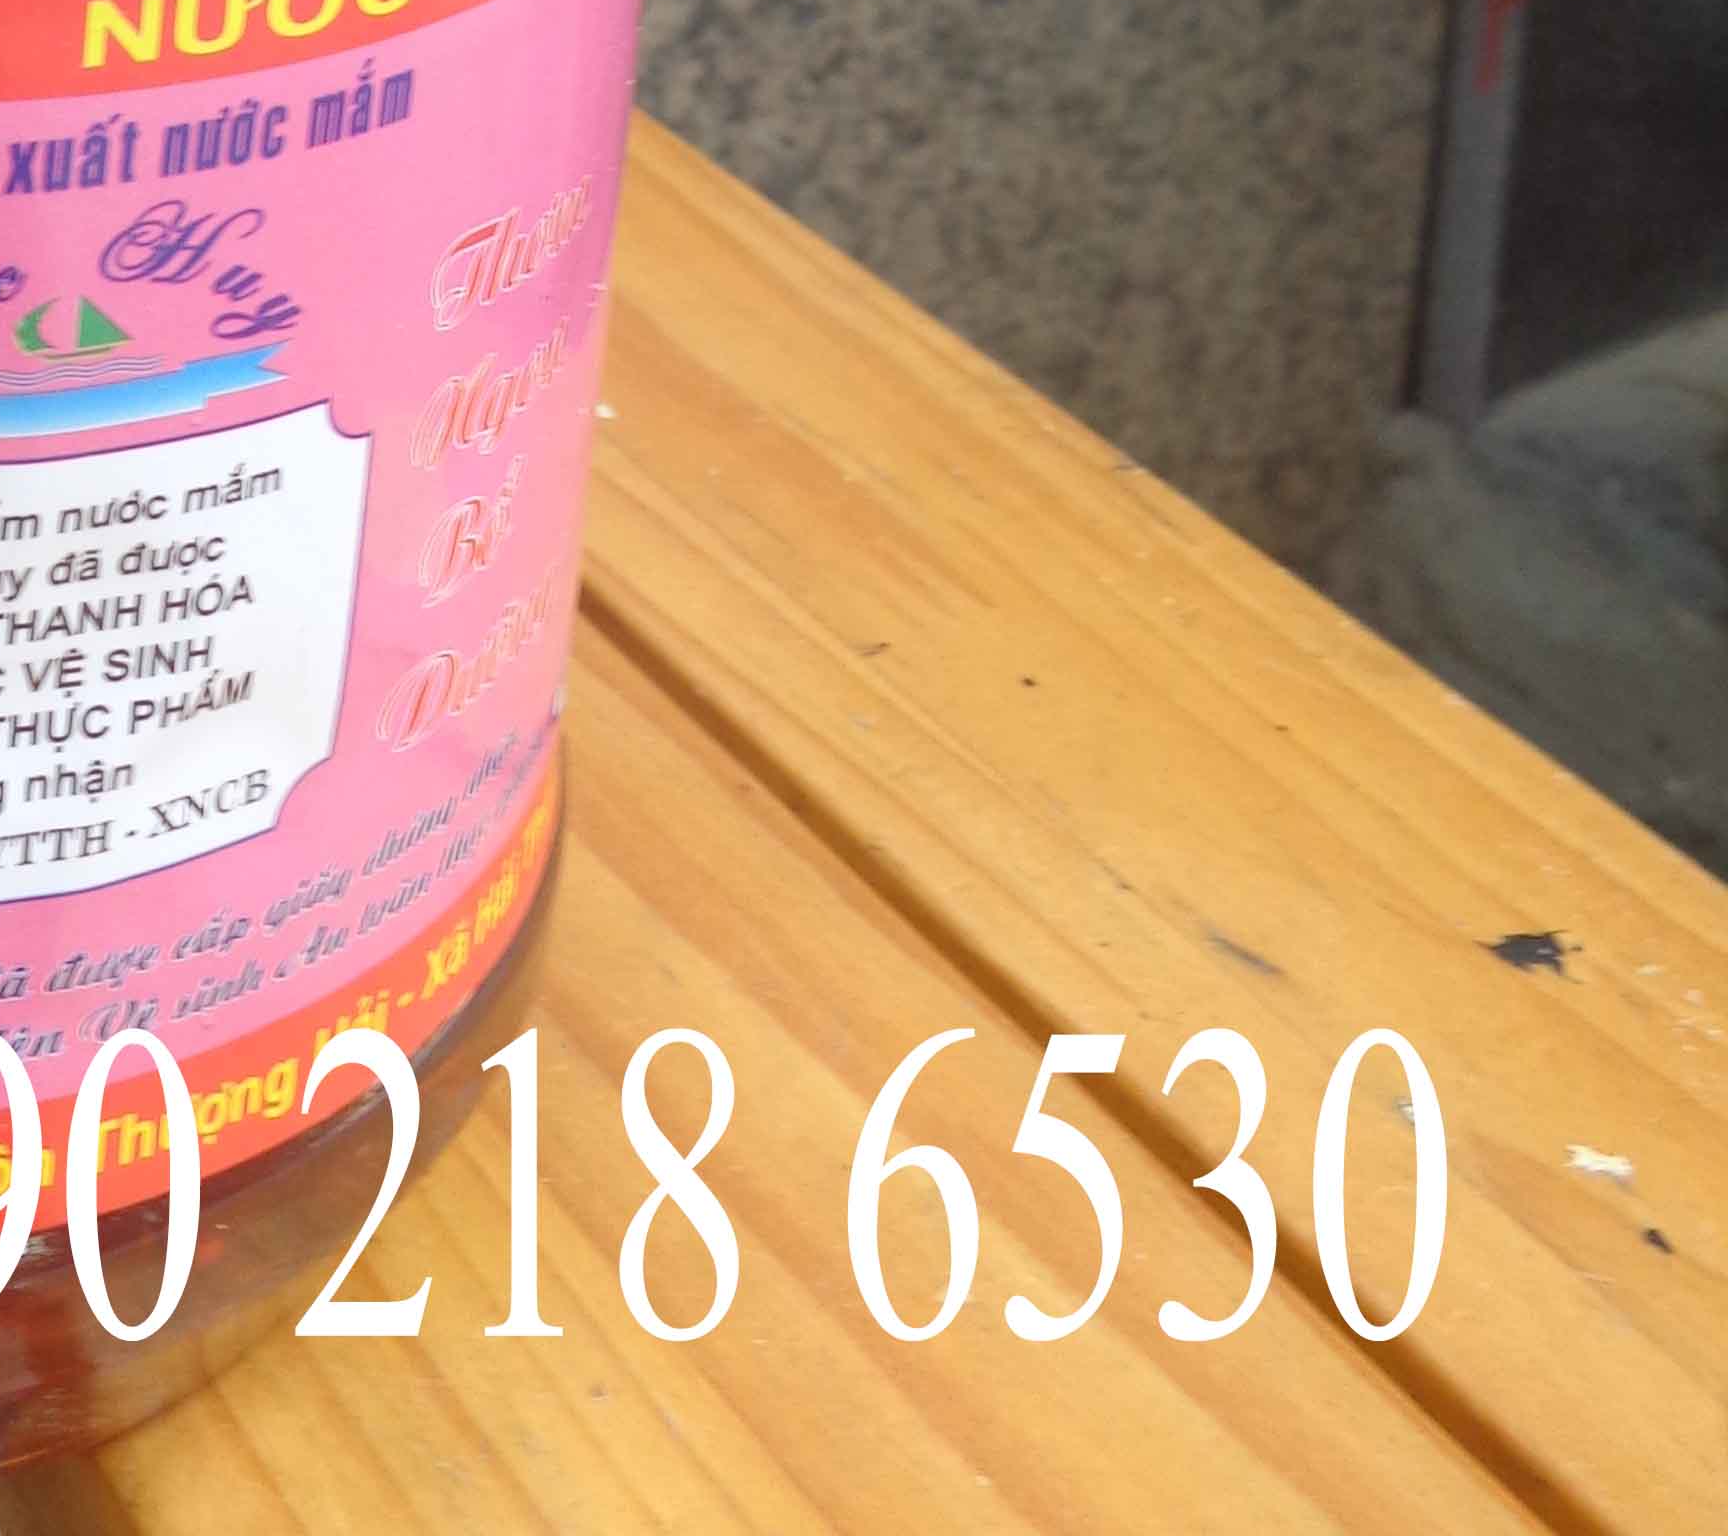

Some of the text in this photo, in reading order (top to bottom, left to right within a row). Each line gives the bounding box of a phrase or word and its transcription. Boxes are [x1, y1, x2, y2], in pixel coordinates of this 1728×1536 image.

[2, 112, 140, 196] xuất
[159, 97, 288, 179] nước
[304, 56, 415, 150] mắm
[99, 199, 302, 341] Huy
[55, 488, 170, 534] nước
[181, 461, 283, 515] mắm
[49, 548, 103, 586] đã
[118, 533, 229, 579] được
[157, 573, 257, 625] HÓA
[22, 648, 86, 696] VỆ
[102, 635, 215, 683] SINH
[24, 760, 137, 804] nhận
[145, 766, 271, 840] XNCB
